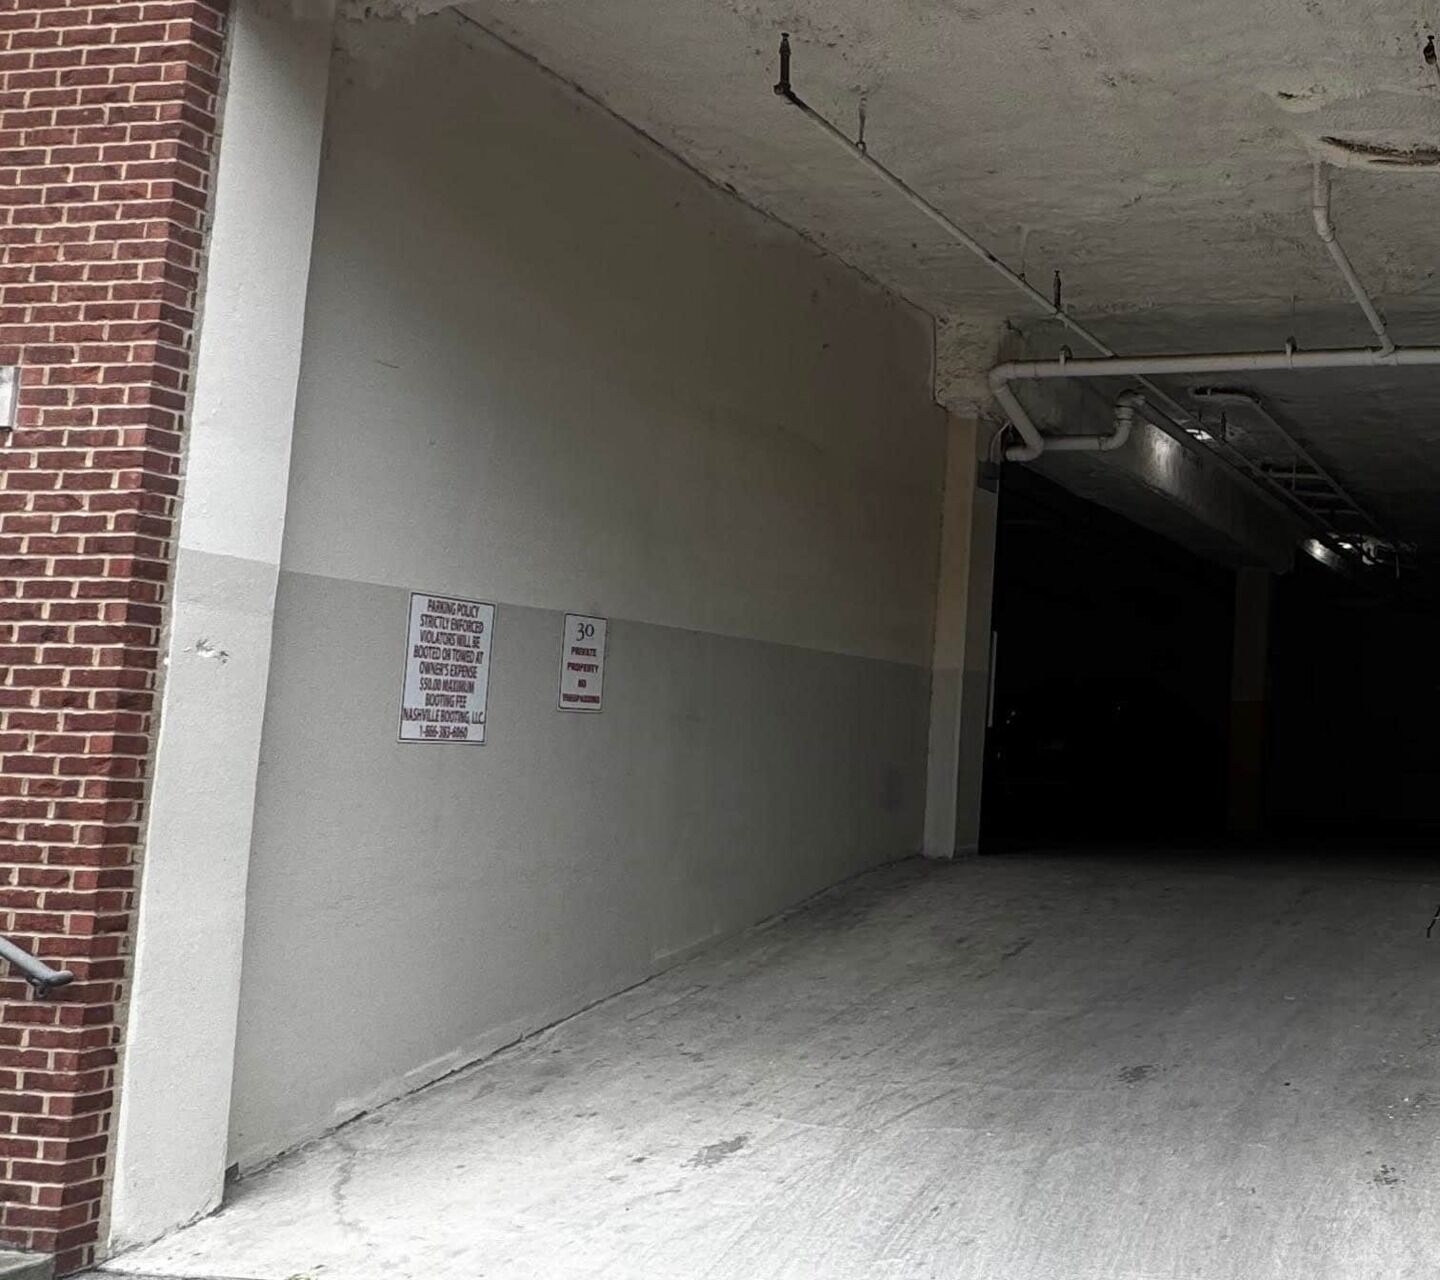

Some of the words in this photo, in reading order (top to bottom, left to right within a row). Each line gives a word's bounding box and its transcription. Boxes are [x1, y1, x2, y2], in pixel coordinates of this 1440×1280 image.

[427, 599, 457, 616] PARKING
[457, 604, 480, 618] POLICY
[420, 614, 449, 629] STRICTLY
[450, 618, 484, 634] ENFORCED
[576, 623, 595, 641] 30
[420, 630, 456, 647] VIOLATORS
[457, 635, 471, 648] WILL
[472, 636, 481, 649] BE
[413, 645, 441, 660] BOOTED
[442, 648, 451, 661] OR
[452, 649, 475, 664] TOWED
[475, 651, 484, 665] AT
[571, 646, 597, 657] PRIVATE
[419, 662, 449, 677] OWNER'S
[450, 664, 478, 679] EXPENSE
[567, 662, 599, 673] PROPERTY
[419, 677, 441, 691] $50.00
[442, 679, 475, 694] MAXIMUM
[425, 693, 455, 708] BOOTING
[456, 695, 468, 709] FEE
[402, 708, 440, 723] NASHVILLE
